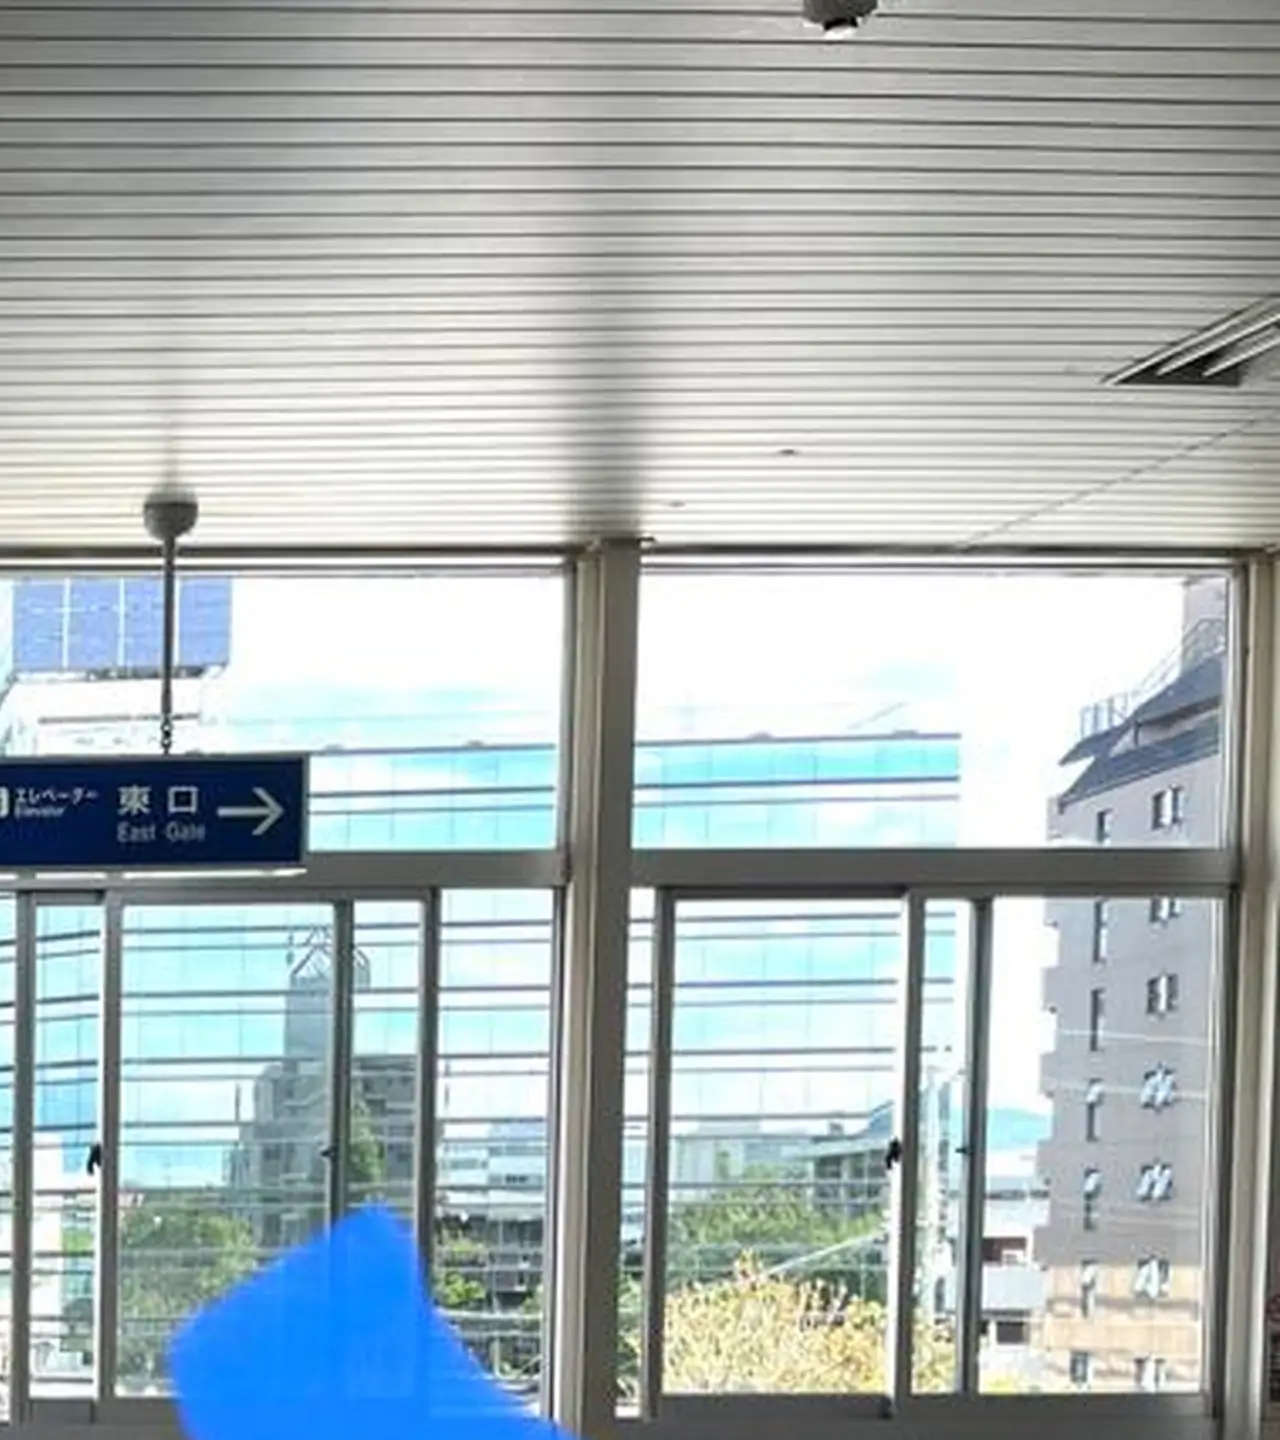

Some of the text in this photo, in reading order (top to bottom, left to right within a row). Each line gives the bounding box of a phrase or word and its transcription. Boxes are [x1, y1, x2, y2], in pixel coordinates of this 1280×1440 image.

[14, 787, 98, 804] エレベーター
[117, 785, 199, 814] 東口
[116, 821, 206, 843] East Gate
